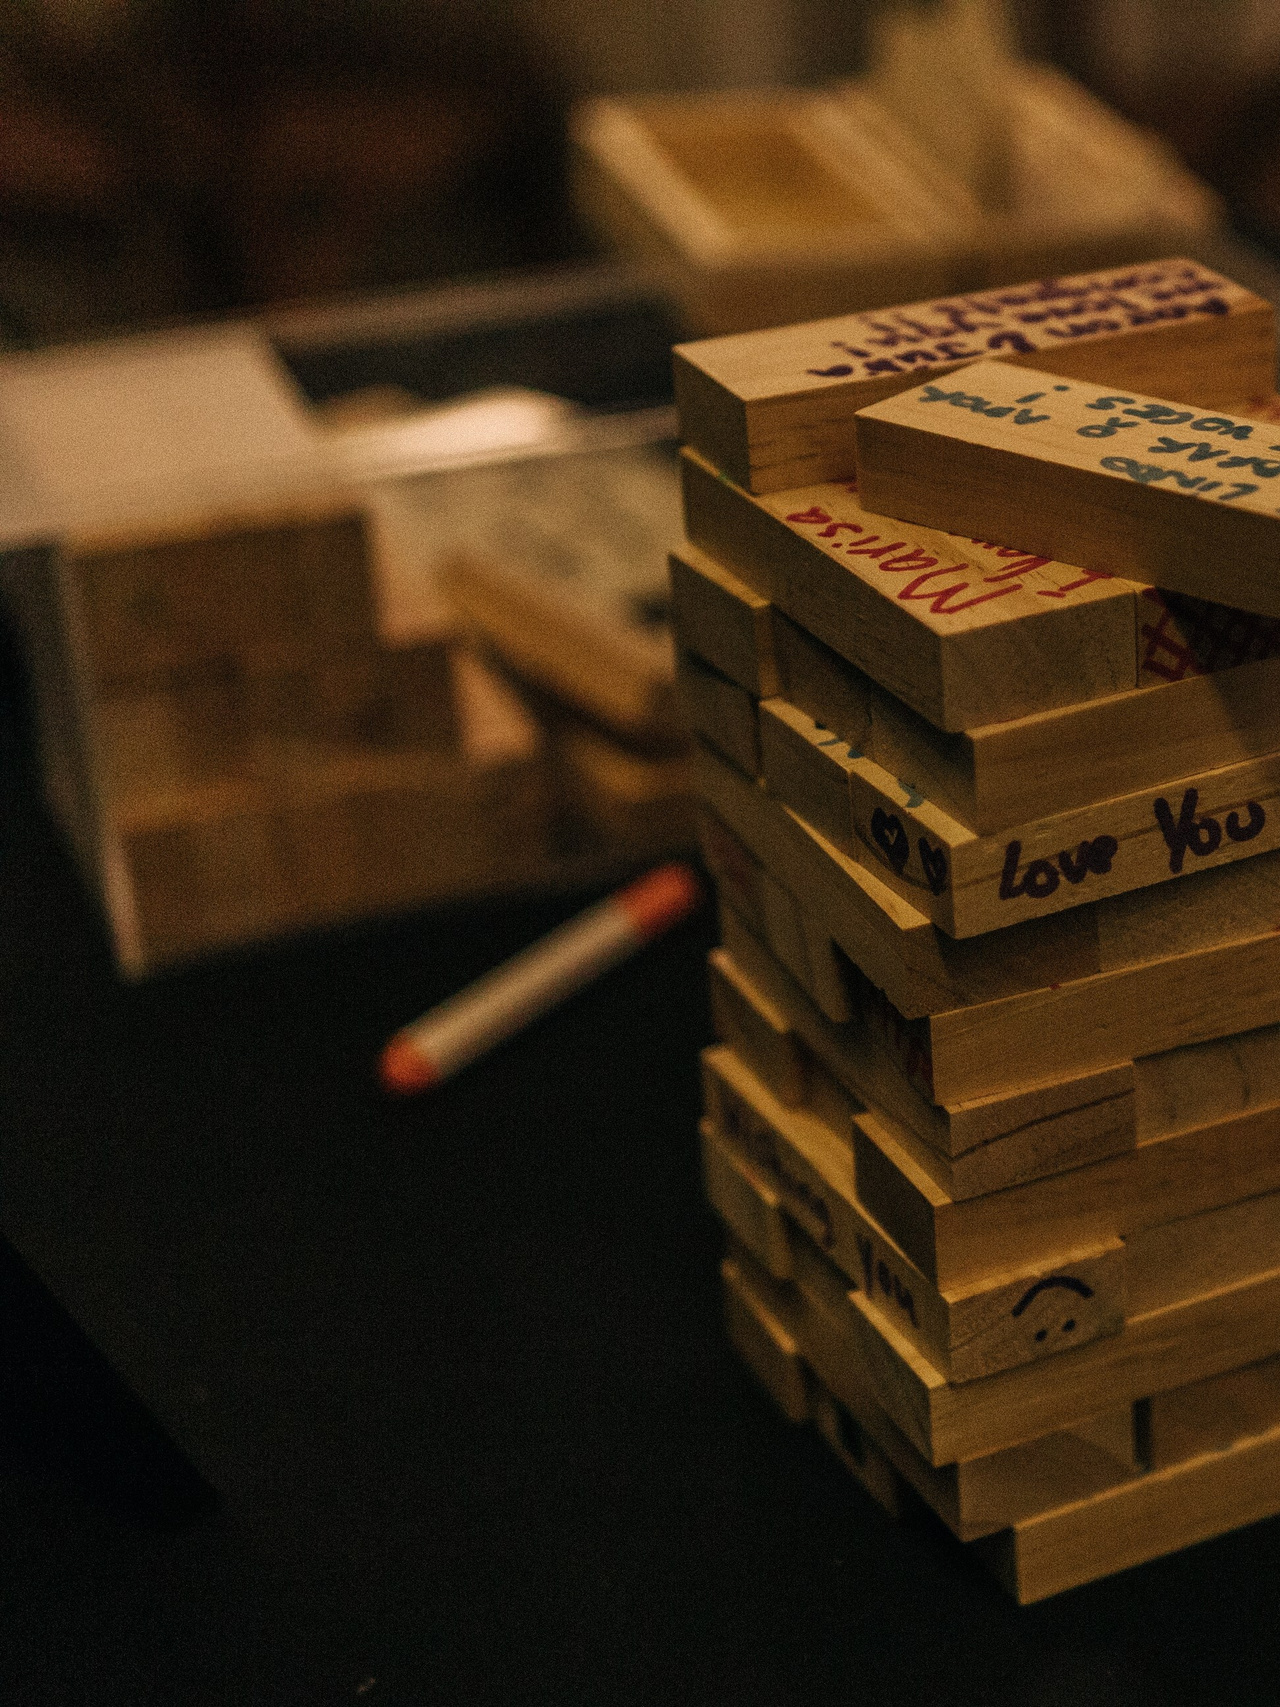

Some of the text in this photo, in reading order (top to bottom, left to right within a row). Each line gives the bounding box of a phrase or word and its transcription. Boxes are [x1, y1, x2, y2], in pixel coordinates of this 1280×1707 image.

[786, 506, 1023, 615] Marisa
[999, 839, 1119, 900] Love
[1153, 787, 1266, 874] You
